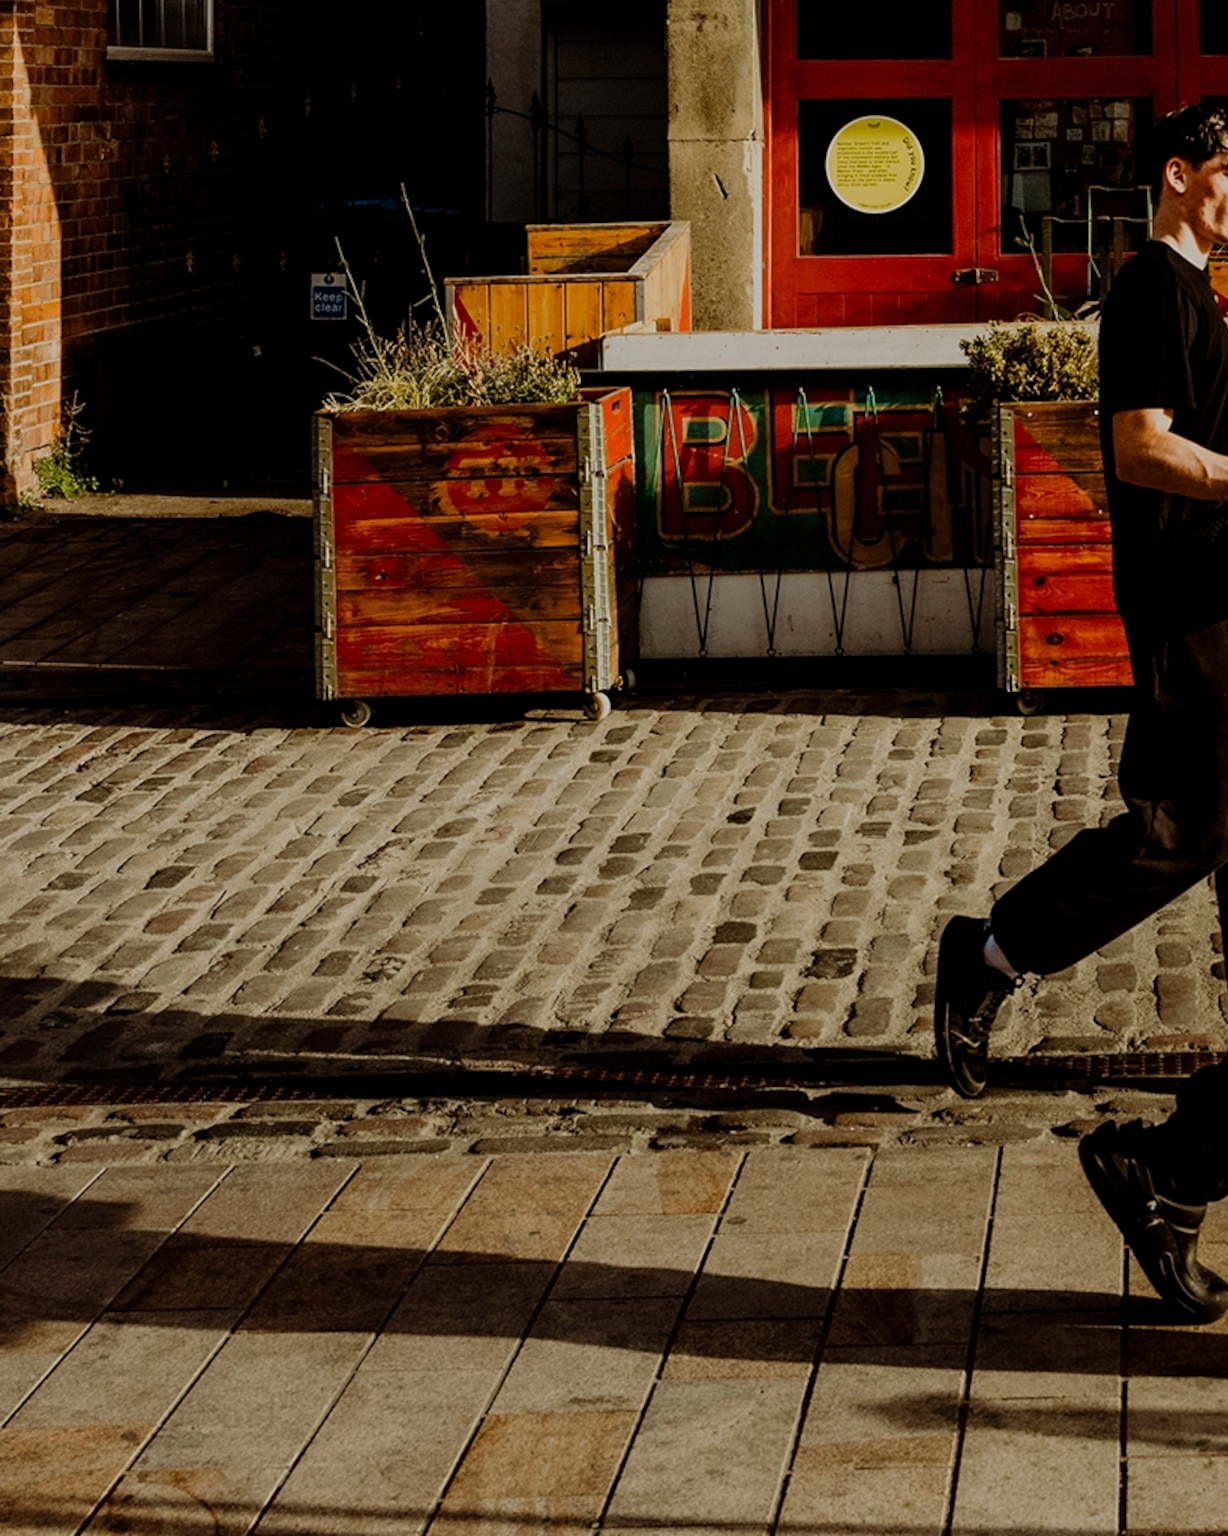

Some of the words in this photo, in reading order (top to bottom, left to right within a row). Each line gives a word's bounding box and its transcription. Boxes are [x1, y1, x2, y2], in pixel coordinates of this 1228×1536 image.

[1051, 0, 1117, 30] ABOUT
[314, 291, 343, 304] Keep
[314, 302, 343, 313] clear
